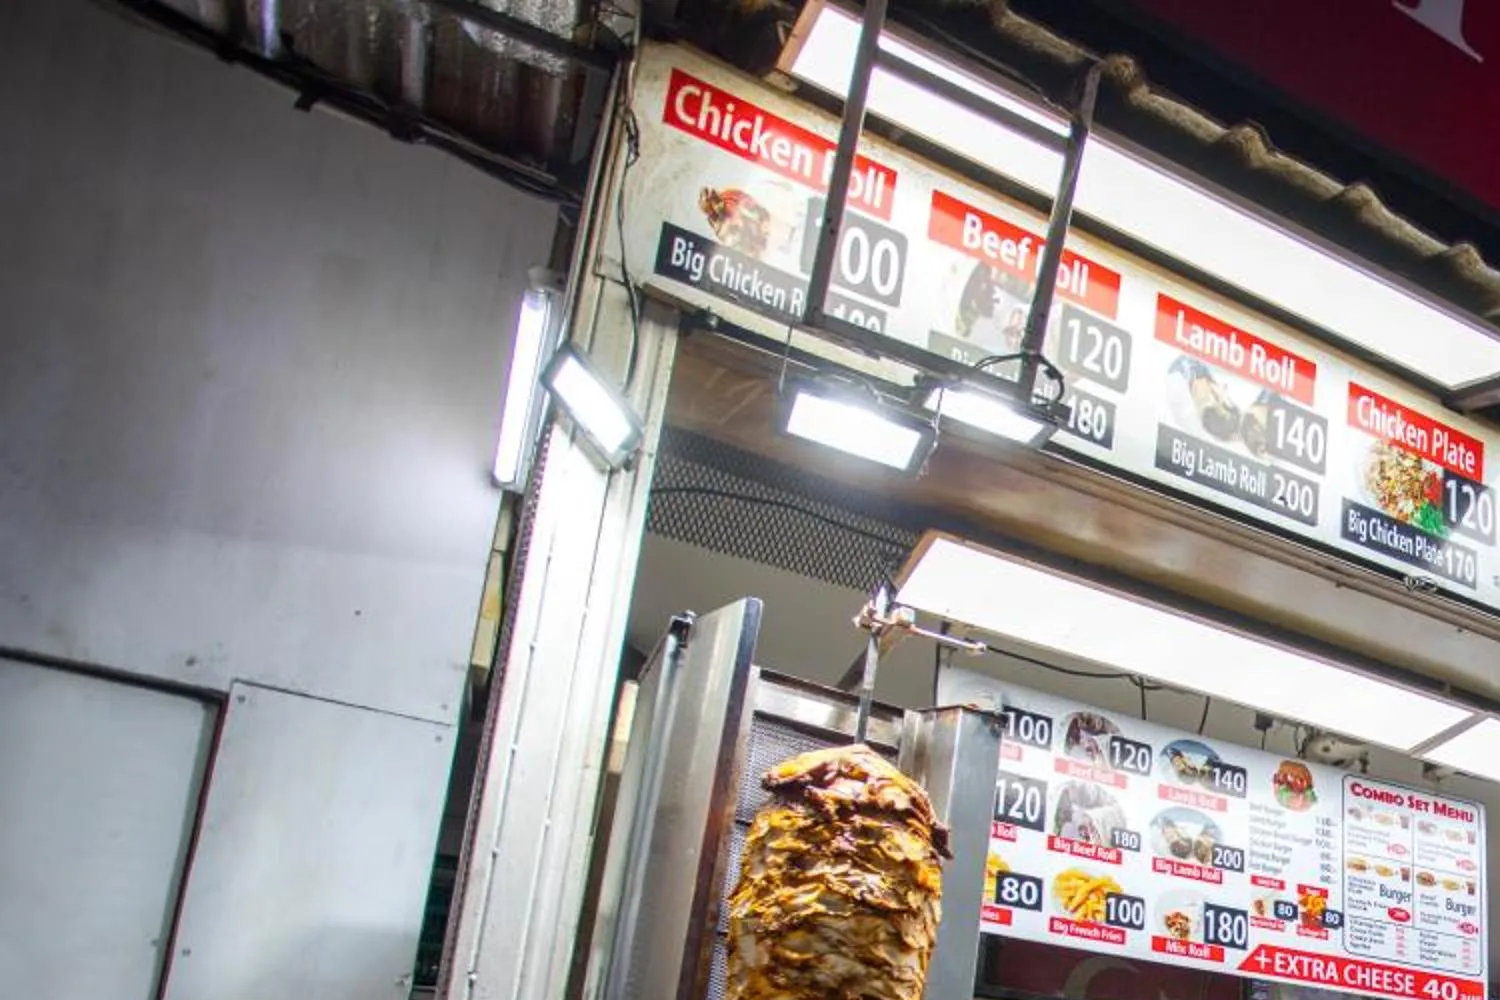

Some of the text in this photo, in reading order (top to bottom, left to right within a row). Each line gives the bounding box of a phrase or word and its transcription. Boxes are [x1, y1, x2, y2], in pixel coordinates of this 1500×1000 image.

[673, 84, 814, 178] Chicken
[816, 214, 898, 297] 00
[962, 213, 1032, 271] Beef
[671, 236, 706, 283] Big
[707, 253, 786, 308] Chicken
[1067, 318, 1124, 381] 120
[1175, 310, 1296, 392] Lamb Roll
[1066, 394, 1107, 439] 180
[1356, 394, 1476, 474] Chicken Plate
[1272, 408, 1325, 464] 140
[1171, 437, 1266, 497] Big Lamb Roll
[1272, 473, 1314, 517] 200
[1445, 479, 1494, 536] 120
[1347, 509, 1445, 568] Big Chicken Plate
[1445, 547, 1475, 584] 170
[1006, 711, 1050, 745] 100
[1110, 739, 1150, 773] 120
[1213, 766, 1245, 792] 140
[996, 780, 1040, 823] 120
[1053, 838, 1117, 863] Big Beef Roll
[1112, 829, 1138, 849] 180
[1214, 847, 1241, 869] 200
[1001, 877, 1038, 905] 80
[1378, 883, 1413, 905] Burger
[1108, 900, 1143, 925] 100
[1205, 910, 1246, 945] 180
[1275, 903, 1293, 917] 80
[1324, 911, 1340, 926] 80
[1165, 939, 1212, 960] Mix Roll
[1343, 966, 1416, 995] CHEESE
